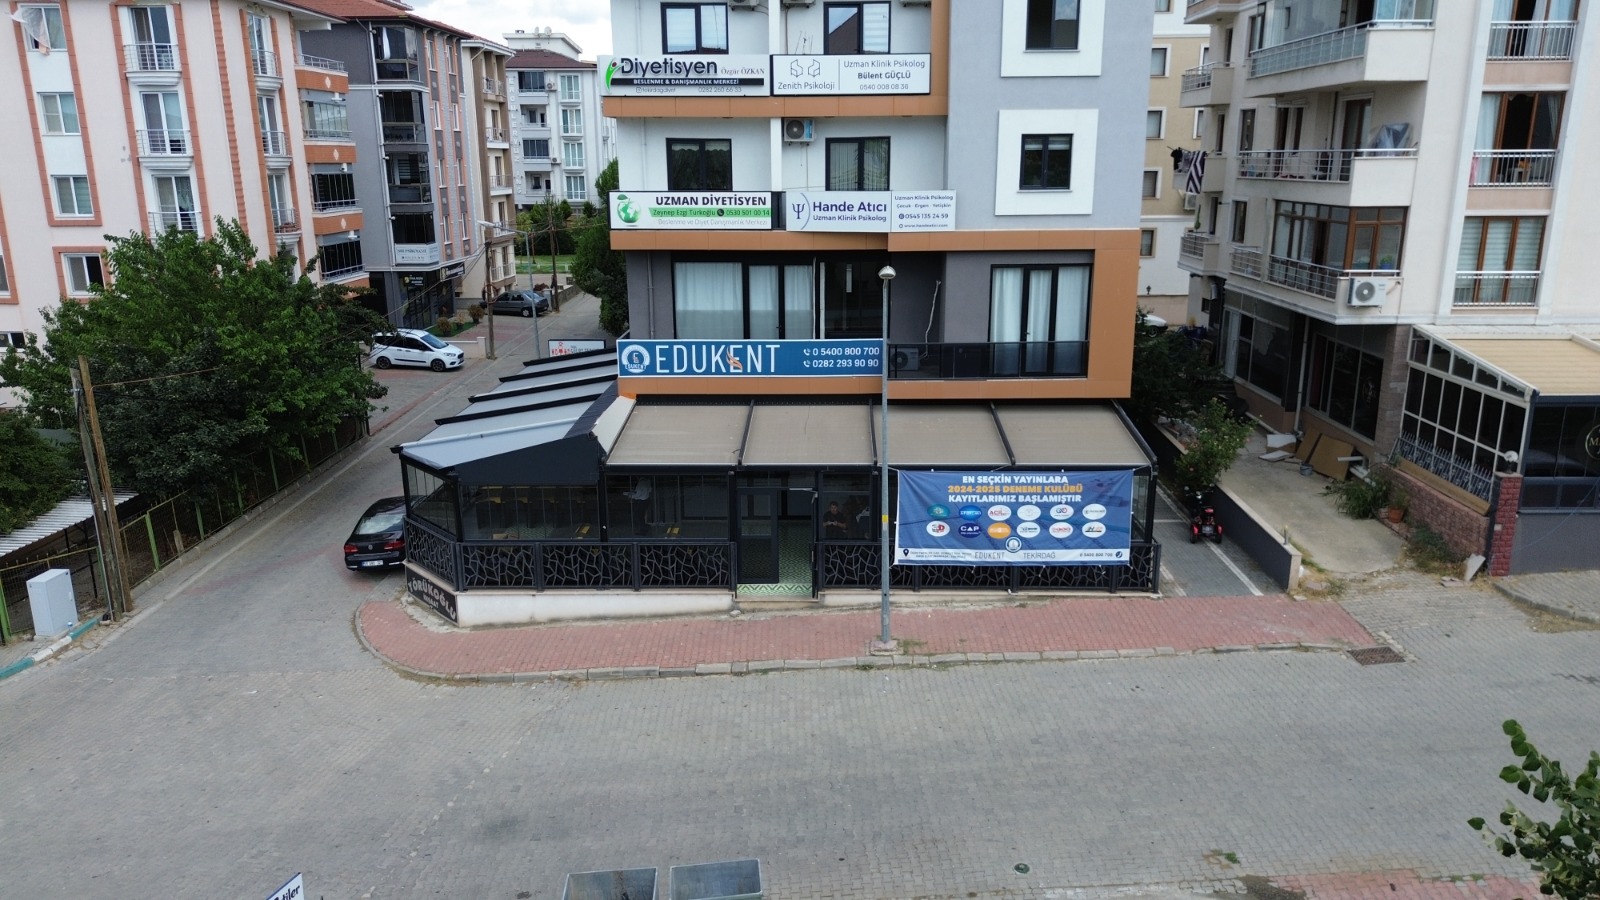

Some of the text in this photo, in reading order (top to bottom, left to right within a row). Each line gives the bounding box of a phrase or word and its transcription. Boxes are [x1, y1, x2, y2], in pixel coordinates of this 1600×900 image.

[621, 58, 717, 77] Diyetisyen
[871, 60, 891, 68] Klinik
[894, 60, 926, 69] Psikolog
[741, 67, 765, 75] ÖZKAN
[885, 71, 911, 80] GÜÇLÜ
[778, 82, 835, 90] Zenith Psikoloji
[656, 194, 766, 206] UZMAN DİYETİSYEN
[813, 201, 887, 212] Hande Atıcı
[677, 209, 688, 217] Ezgi
[858, 215, 887, 223] Psikolog
[813, 347, 880, 356] 0 5400 800 700
[656, 345, 780, 373] EDUKENT
[813, 359, 879, 368] 0282 293 90 90
[963, 474, 1069, 485] EN SEÇKİN YAYINLARA
[1044, 484, 1083, 493] KULÜBÜ
[949, 495, 1082, 504] KAYITLARIMIZ BAŞLAMIŞTIR
[1023, 551, 1056, 559] TEKİRDAĞ
[408, 577, 456, 620] YÖRÜKOĞLU
